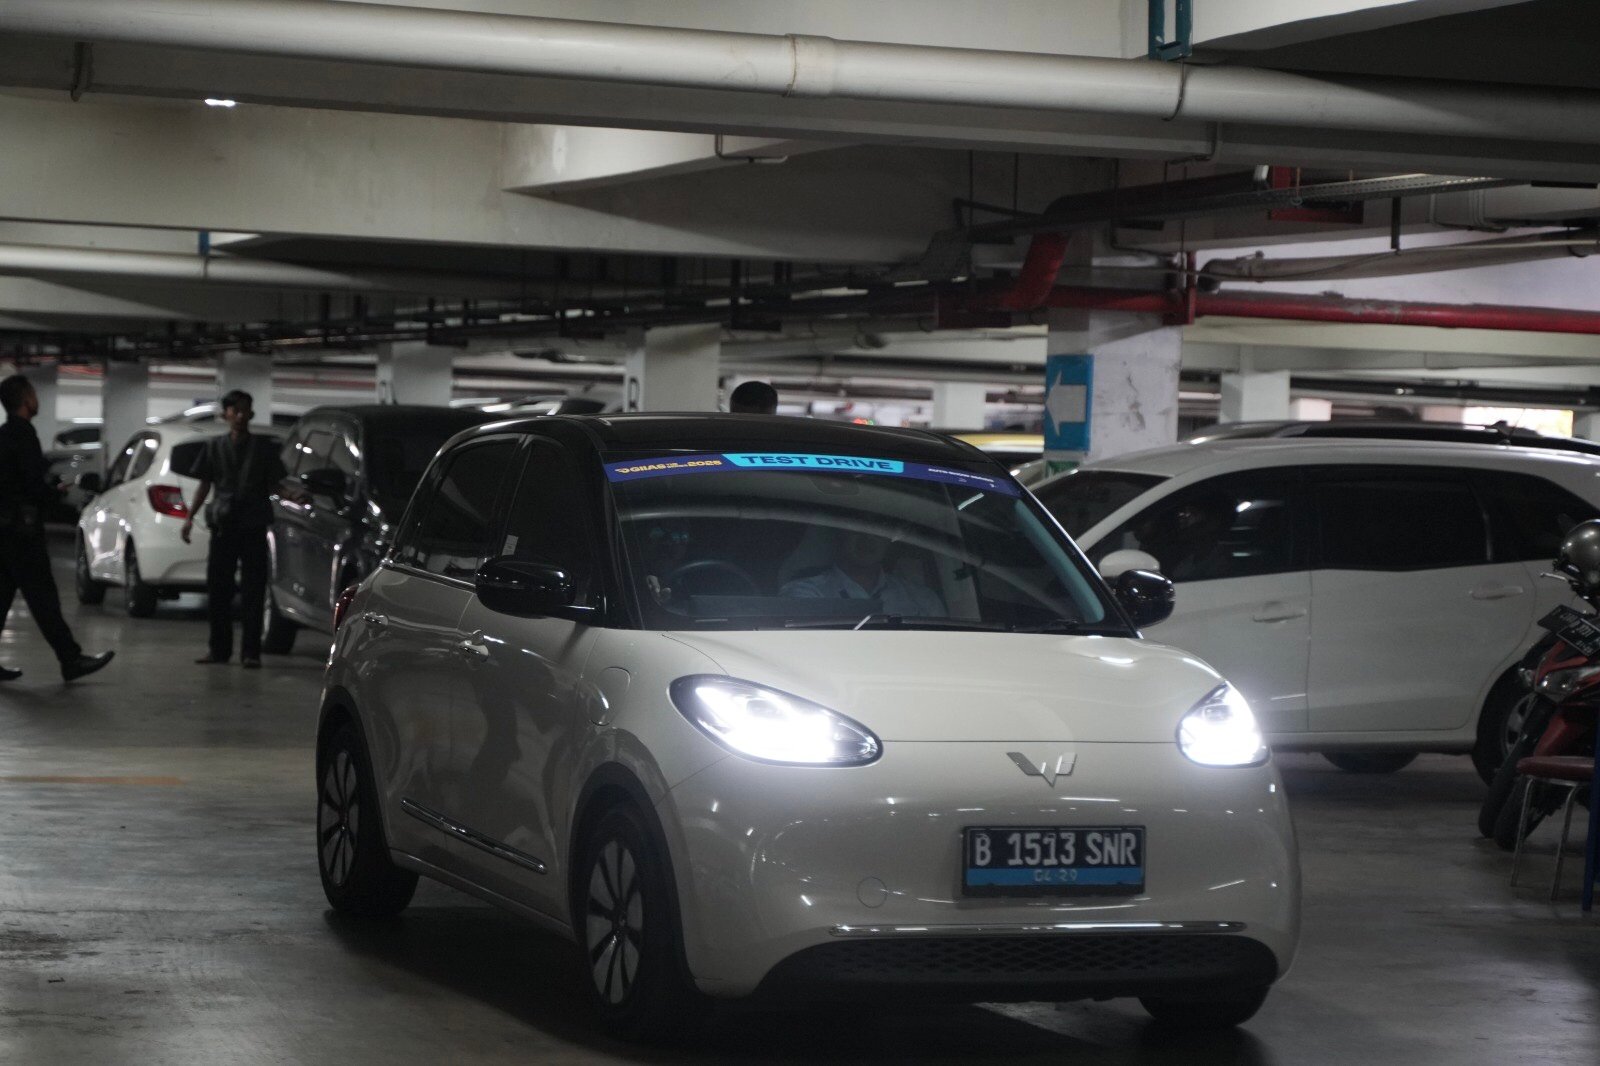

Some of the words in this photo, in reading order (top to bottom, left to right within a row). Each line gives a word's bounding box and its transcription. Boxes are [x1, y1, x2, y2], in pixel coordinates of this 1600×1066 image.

[742, 456, 808, 465] TEST
[816, 457, 893, 470] DRIVE
[974, 833, 991, 866] B
[1008, 832, 1076, 866] 1513
[1085, 832, 1137, 865] SNR
